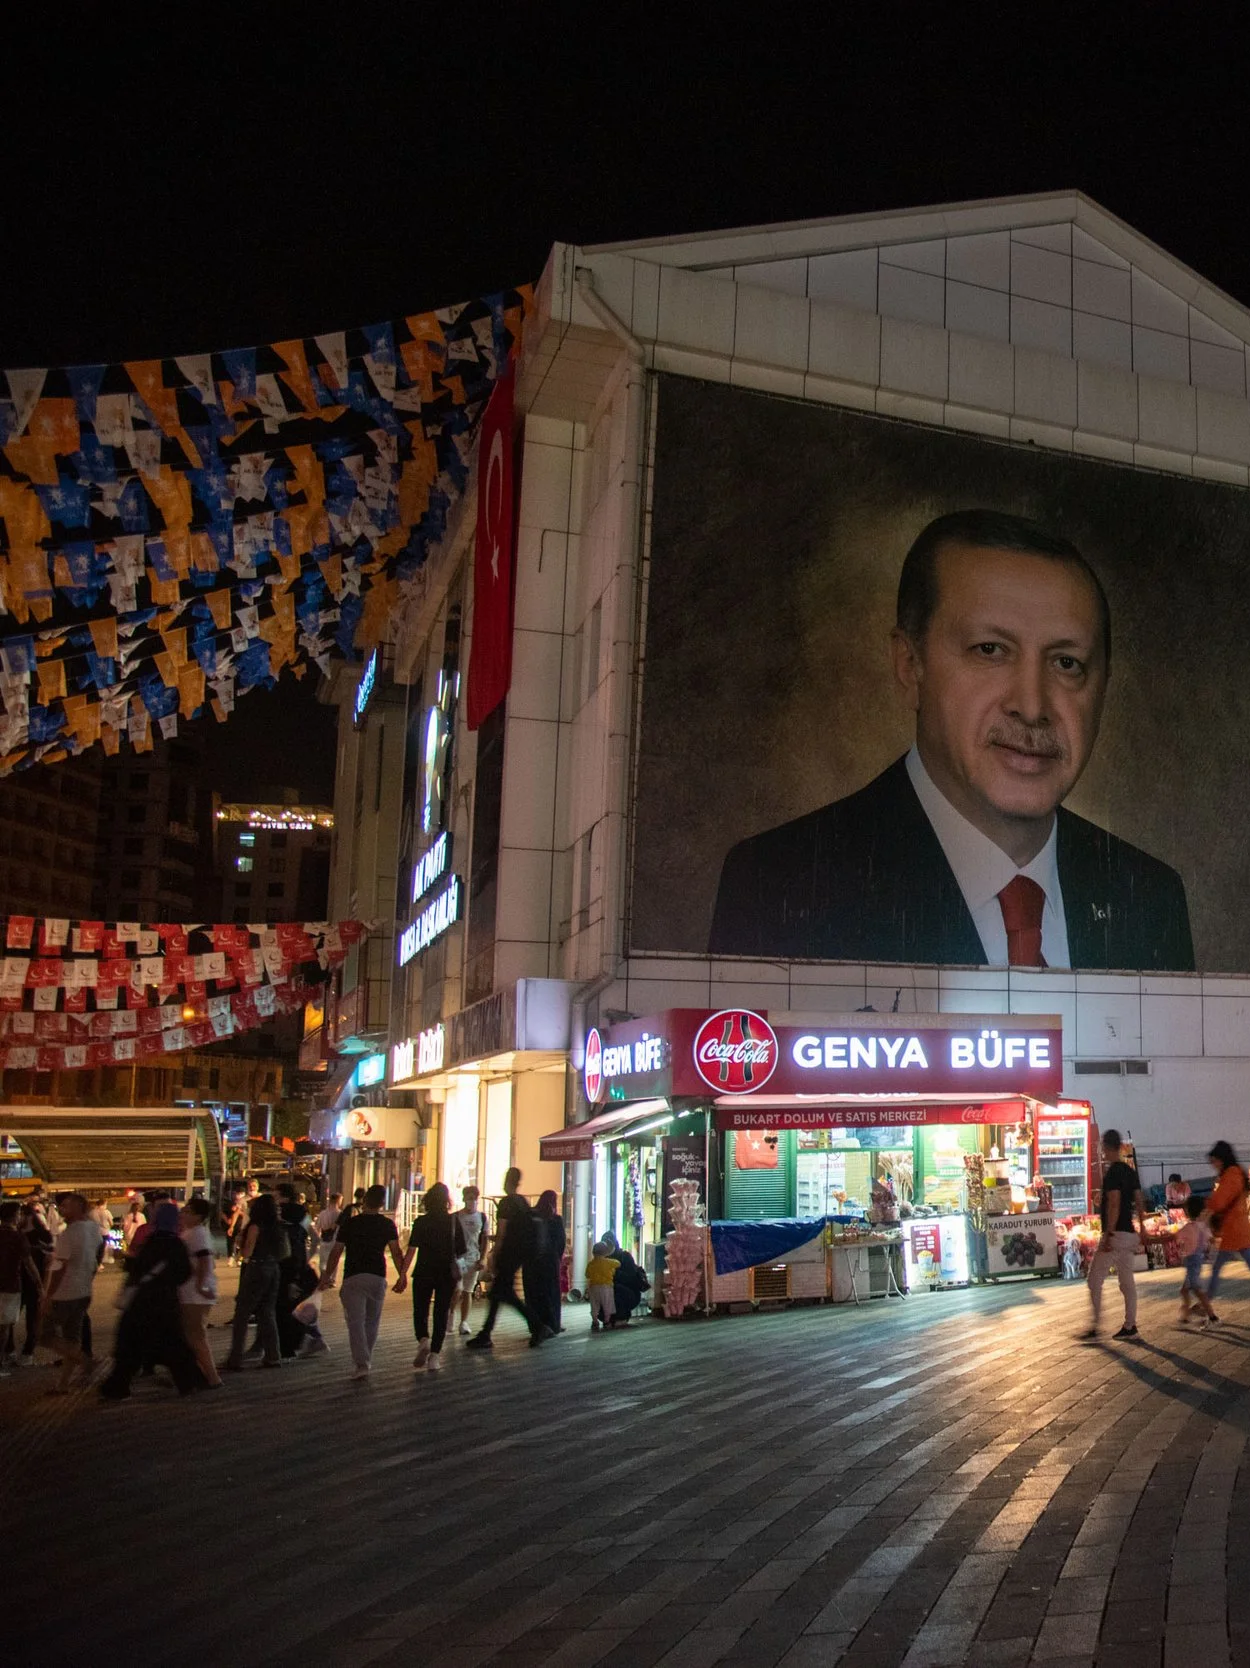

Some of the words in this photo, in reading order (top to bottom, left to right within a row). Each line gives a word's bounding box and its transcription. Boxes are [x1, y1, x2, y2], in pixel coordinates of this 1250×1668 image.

[603, 1044, 632, 1077] GENYA
[635, 1033, 661, 1073] BÜFE
[792, 1035, 928, 1069] GENYA
[951, 1030, 1050, 1068] BÜFE
[733, 1113, 781, 1125] BUKART
[784, 1112, 825, 1124] DOLUM
[828, 1112, 843, 1123] VE
[846, 1111, 877, 1124] SATIŞ
[879, 1109, 926, 1121] MERKEZİ
[988, 1220, 1022, 1231] KARADUT
[1024, 1217, 1052, 1228] ŞURUBU
